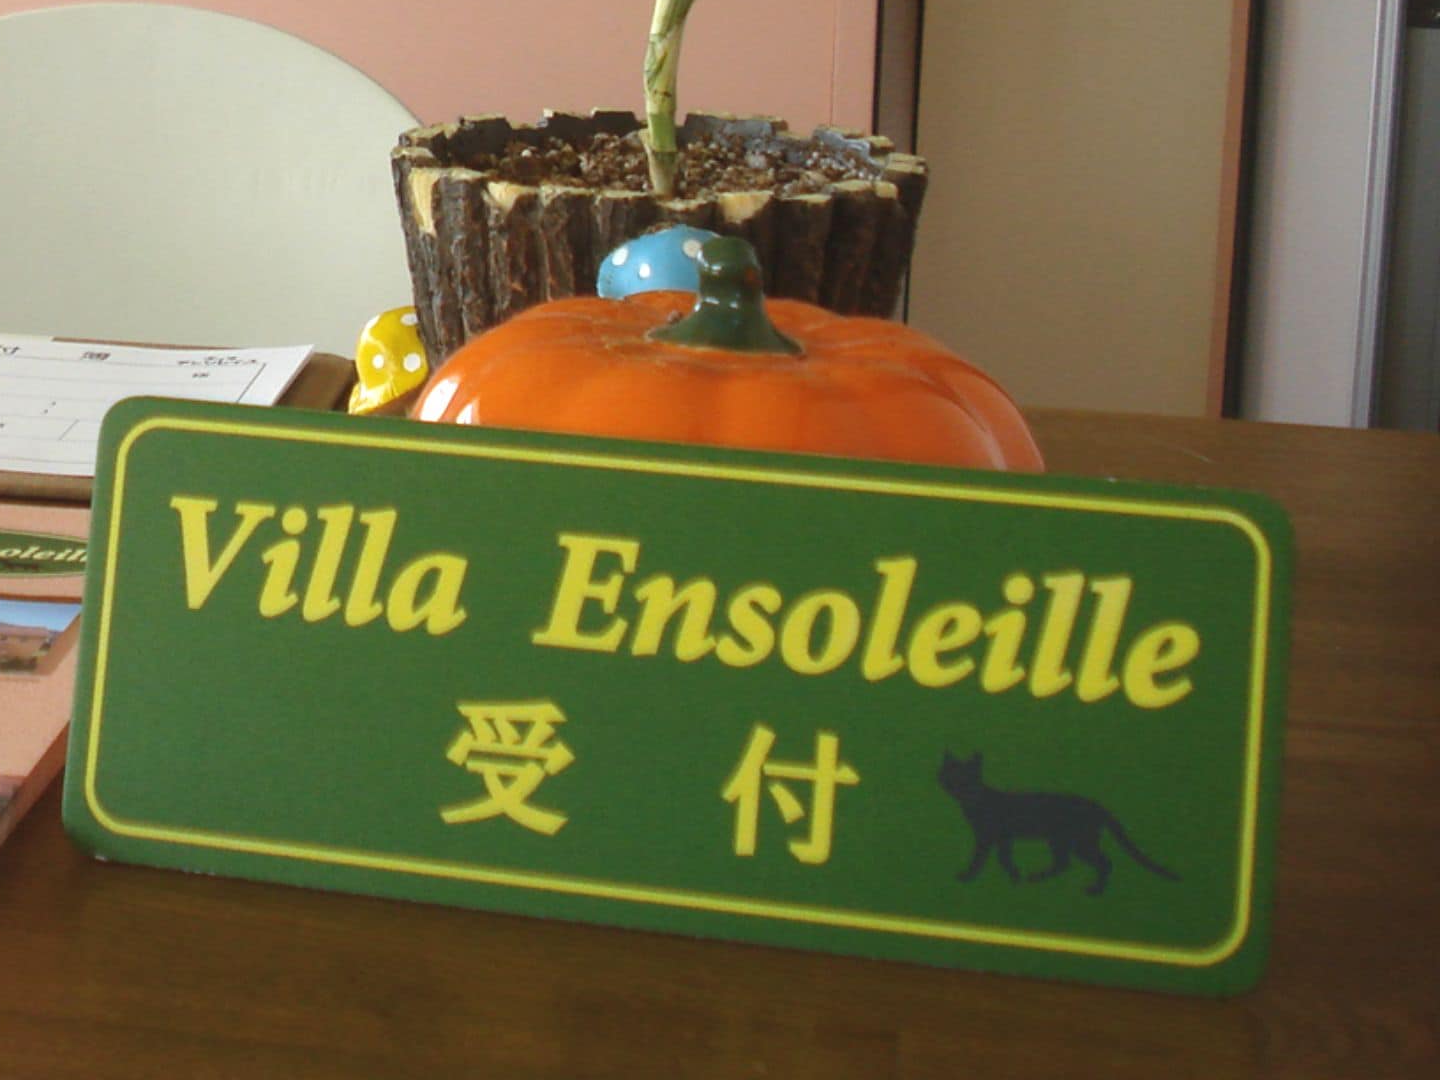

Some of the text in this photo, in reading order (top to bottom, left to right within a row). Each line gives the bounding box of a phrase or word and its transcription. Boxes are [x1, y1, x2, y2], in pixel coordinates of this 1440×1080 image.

[169, 496, 1201, 710] Villa Ensoleille
[440, 698, 859, 866] 受 付
